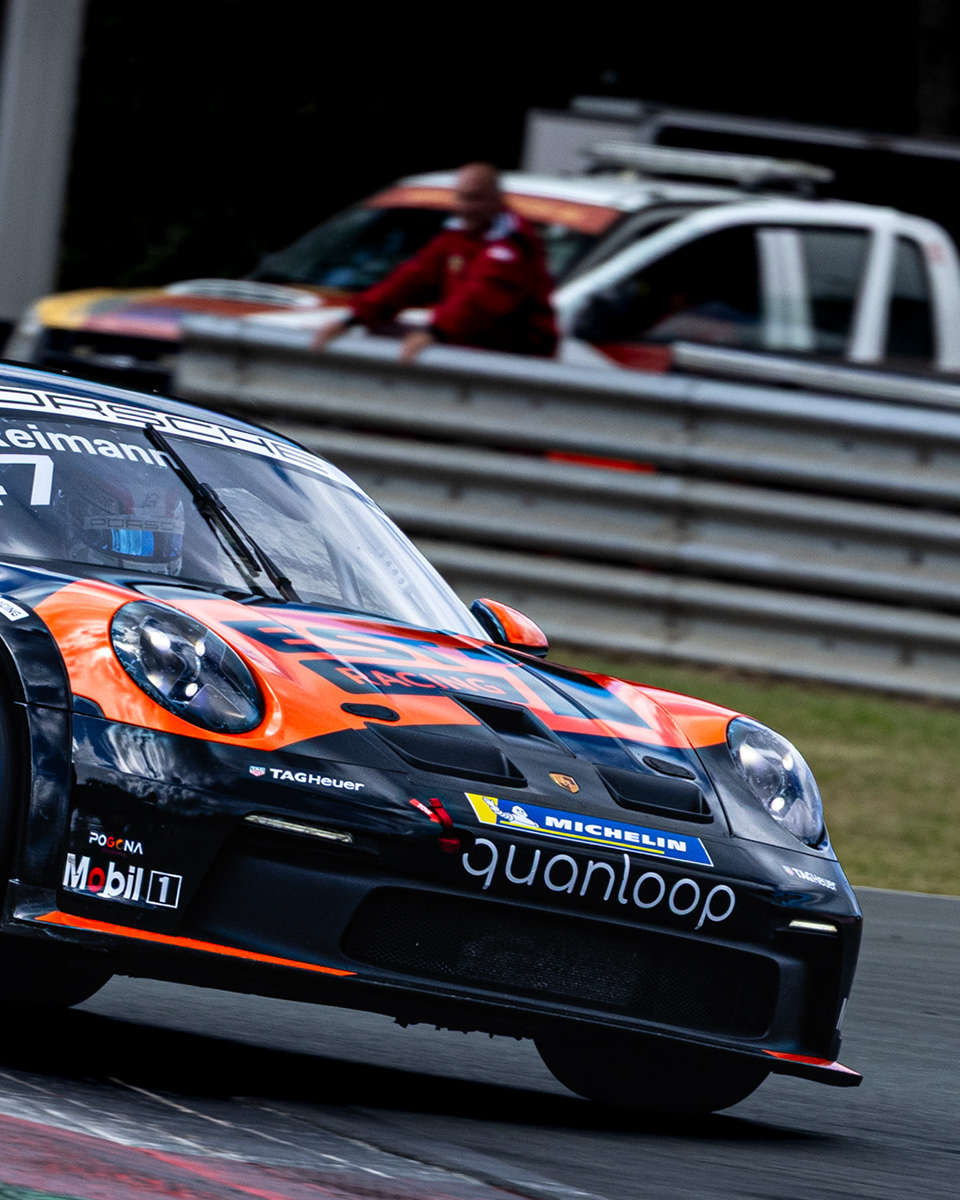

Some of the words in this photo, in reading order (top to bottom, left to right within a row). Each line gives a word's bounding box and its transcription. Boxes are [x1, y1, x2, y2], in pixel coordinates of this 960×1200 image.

[337, 667, 507, 695] RACING
[88, 831, 144, 855] POGONA
[545, 816, 687, 852] MICHELIN
[62, 852, 144, 902] Mobil
[462, 838, 735, 930] quanloop
